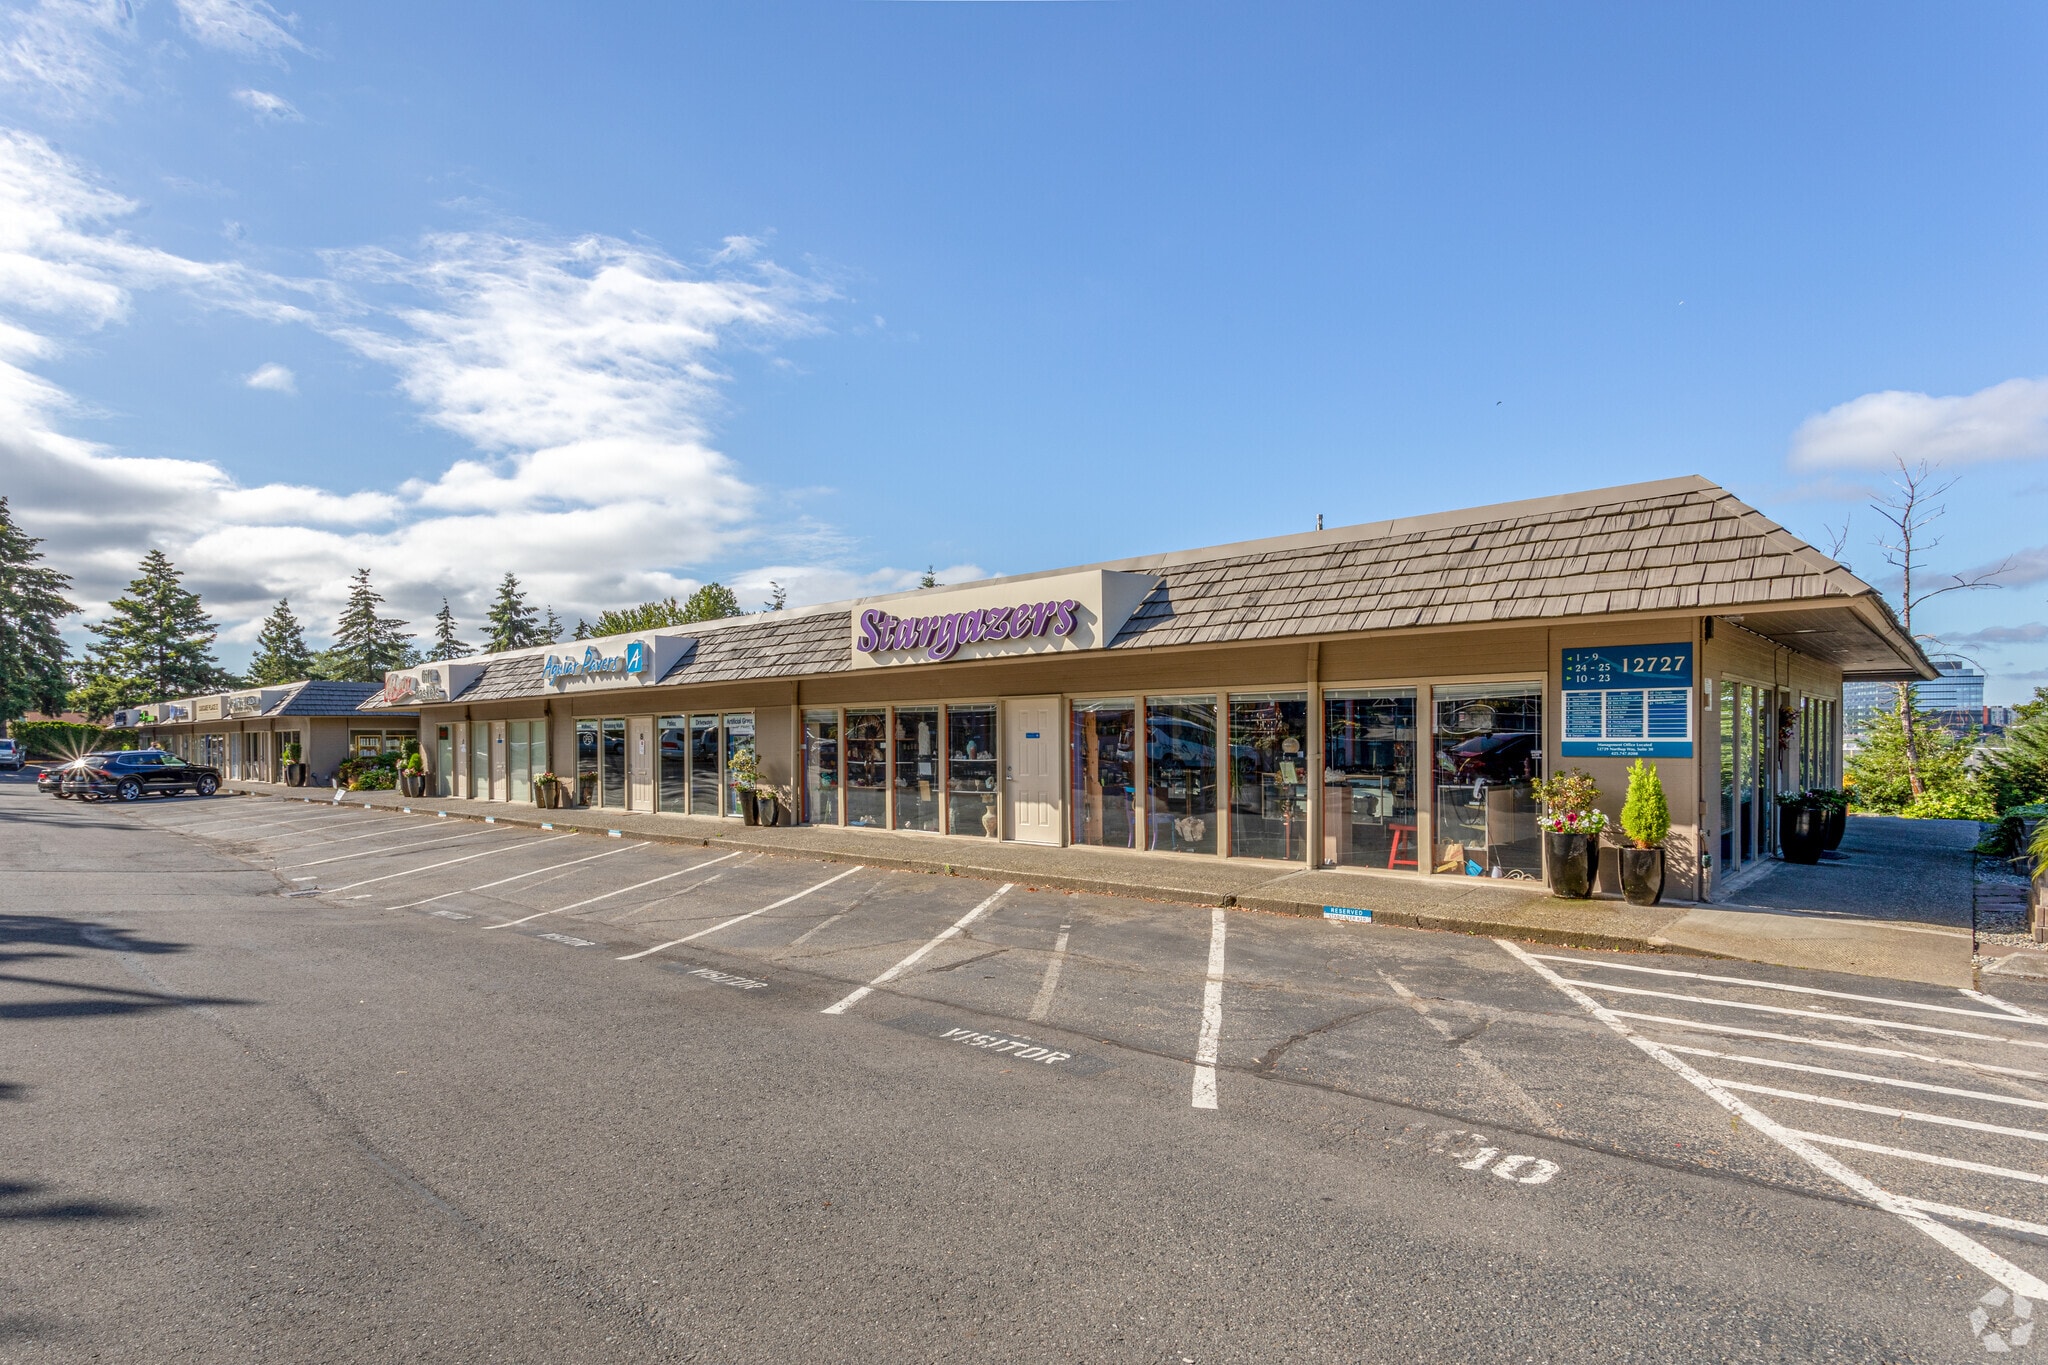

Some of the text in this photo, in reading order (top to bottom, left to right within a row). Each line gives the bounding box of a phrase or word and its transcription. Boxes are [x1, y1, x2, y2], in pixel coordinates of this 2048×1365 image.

[857, 599, 1080, 660] Stargazers
[1576, 653, 1580, 661] 1
[1592, 652, 1599, 661] 9
[542, 646, 618, 686] Aguiar Pavers
[1575, 664, 1587, 672] 24
[1598, 663, 1611, 672] 25
[1622, 656, 1686, 673] 12727
[1576, 674, 1588, 682] 10
[1598, 674, 1611, 682] 23
[1330, 908, 1363, 916] RESERVED
[938, 1027, 1071, 1064] VISITOR
